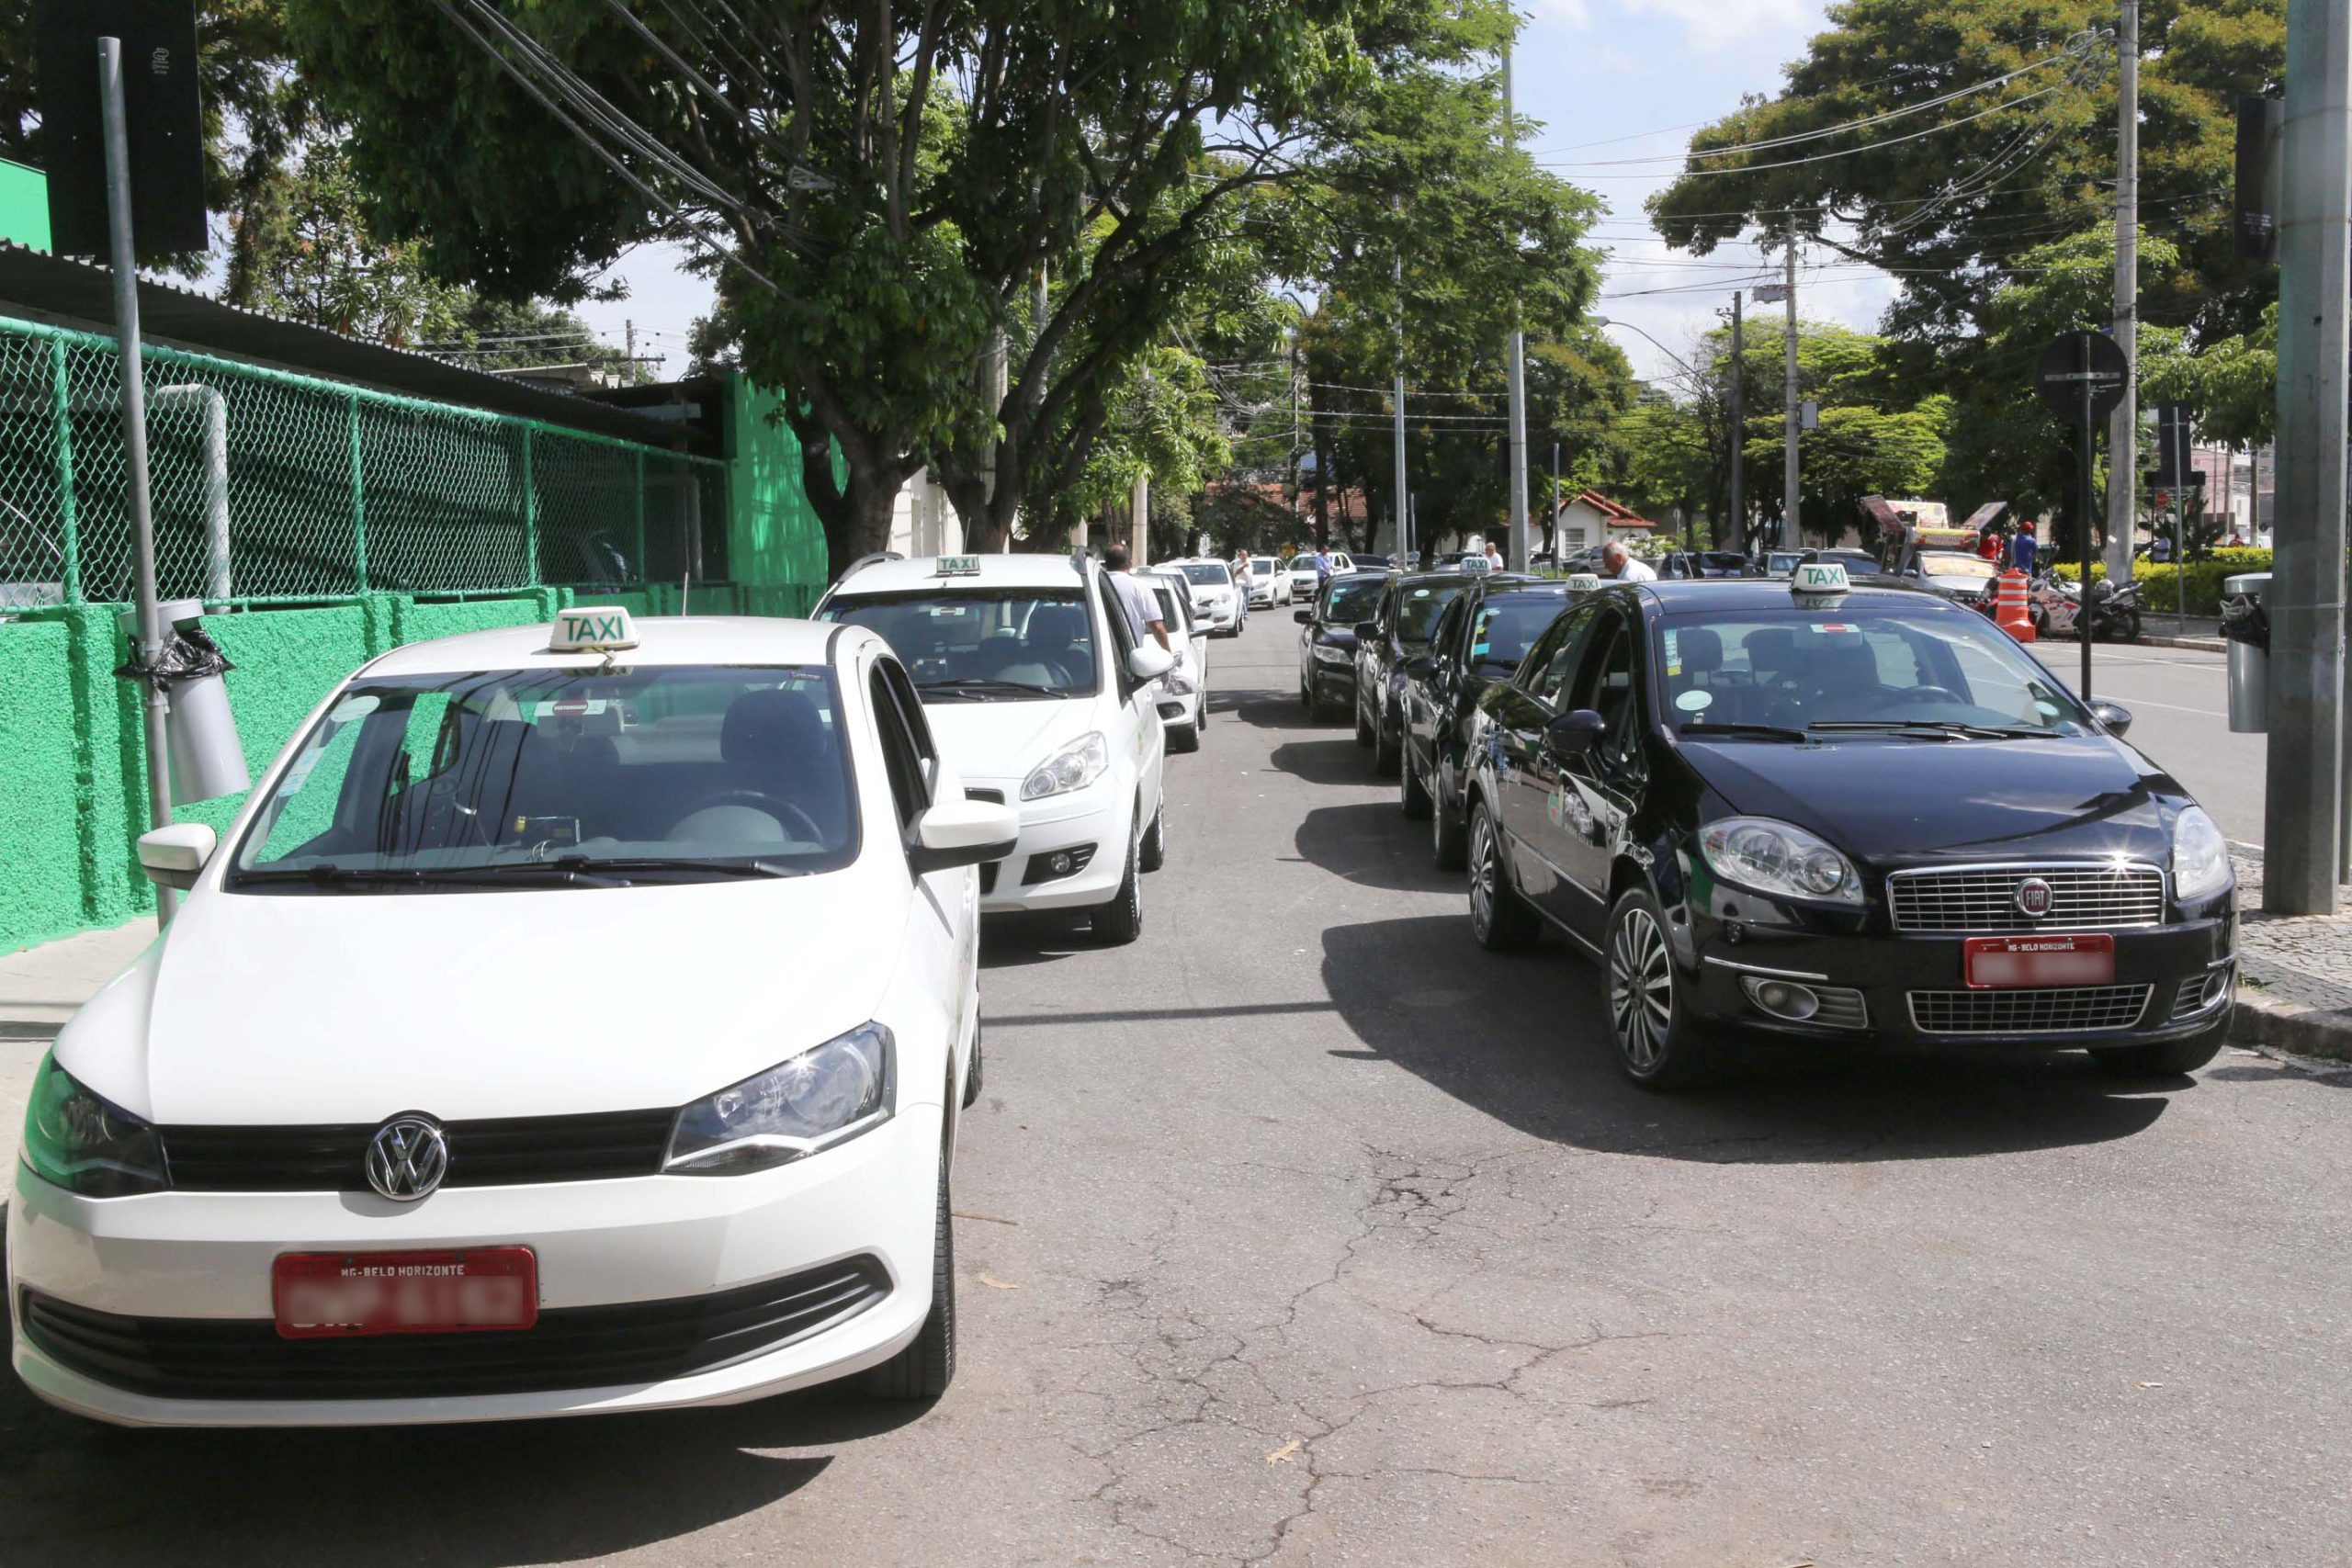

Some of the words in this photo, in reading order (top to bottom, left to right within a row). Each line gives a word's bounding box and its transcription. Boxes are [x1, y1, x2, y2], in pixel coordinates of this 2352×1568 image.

[940, 558, 976, 569] TAXI
[1464, 559, 1487, 569] TAXI
[1803, 568, 1845, 585] TAXI
[1572, 580, 1599, 589] TAXI
[562, 616, 624, 641] TAXI
[2026, 890, 2045, 907] FIAT
[2039, 942, 2075, 951] HORIZONTE
[398, 1265, 465, 1276] HORIZONTE
